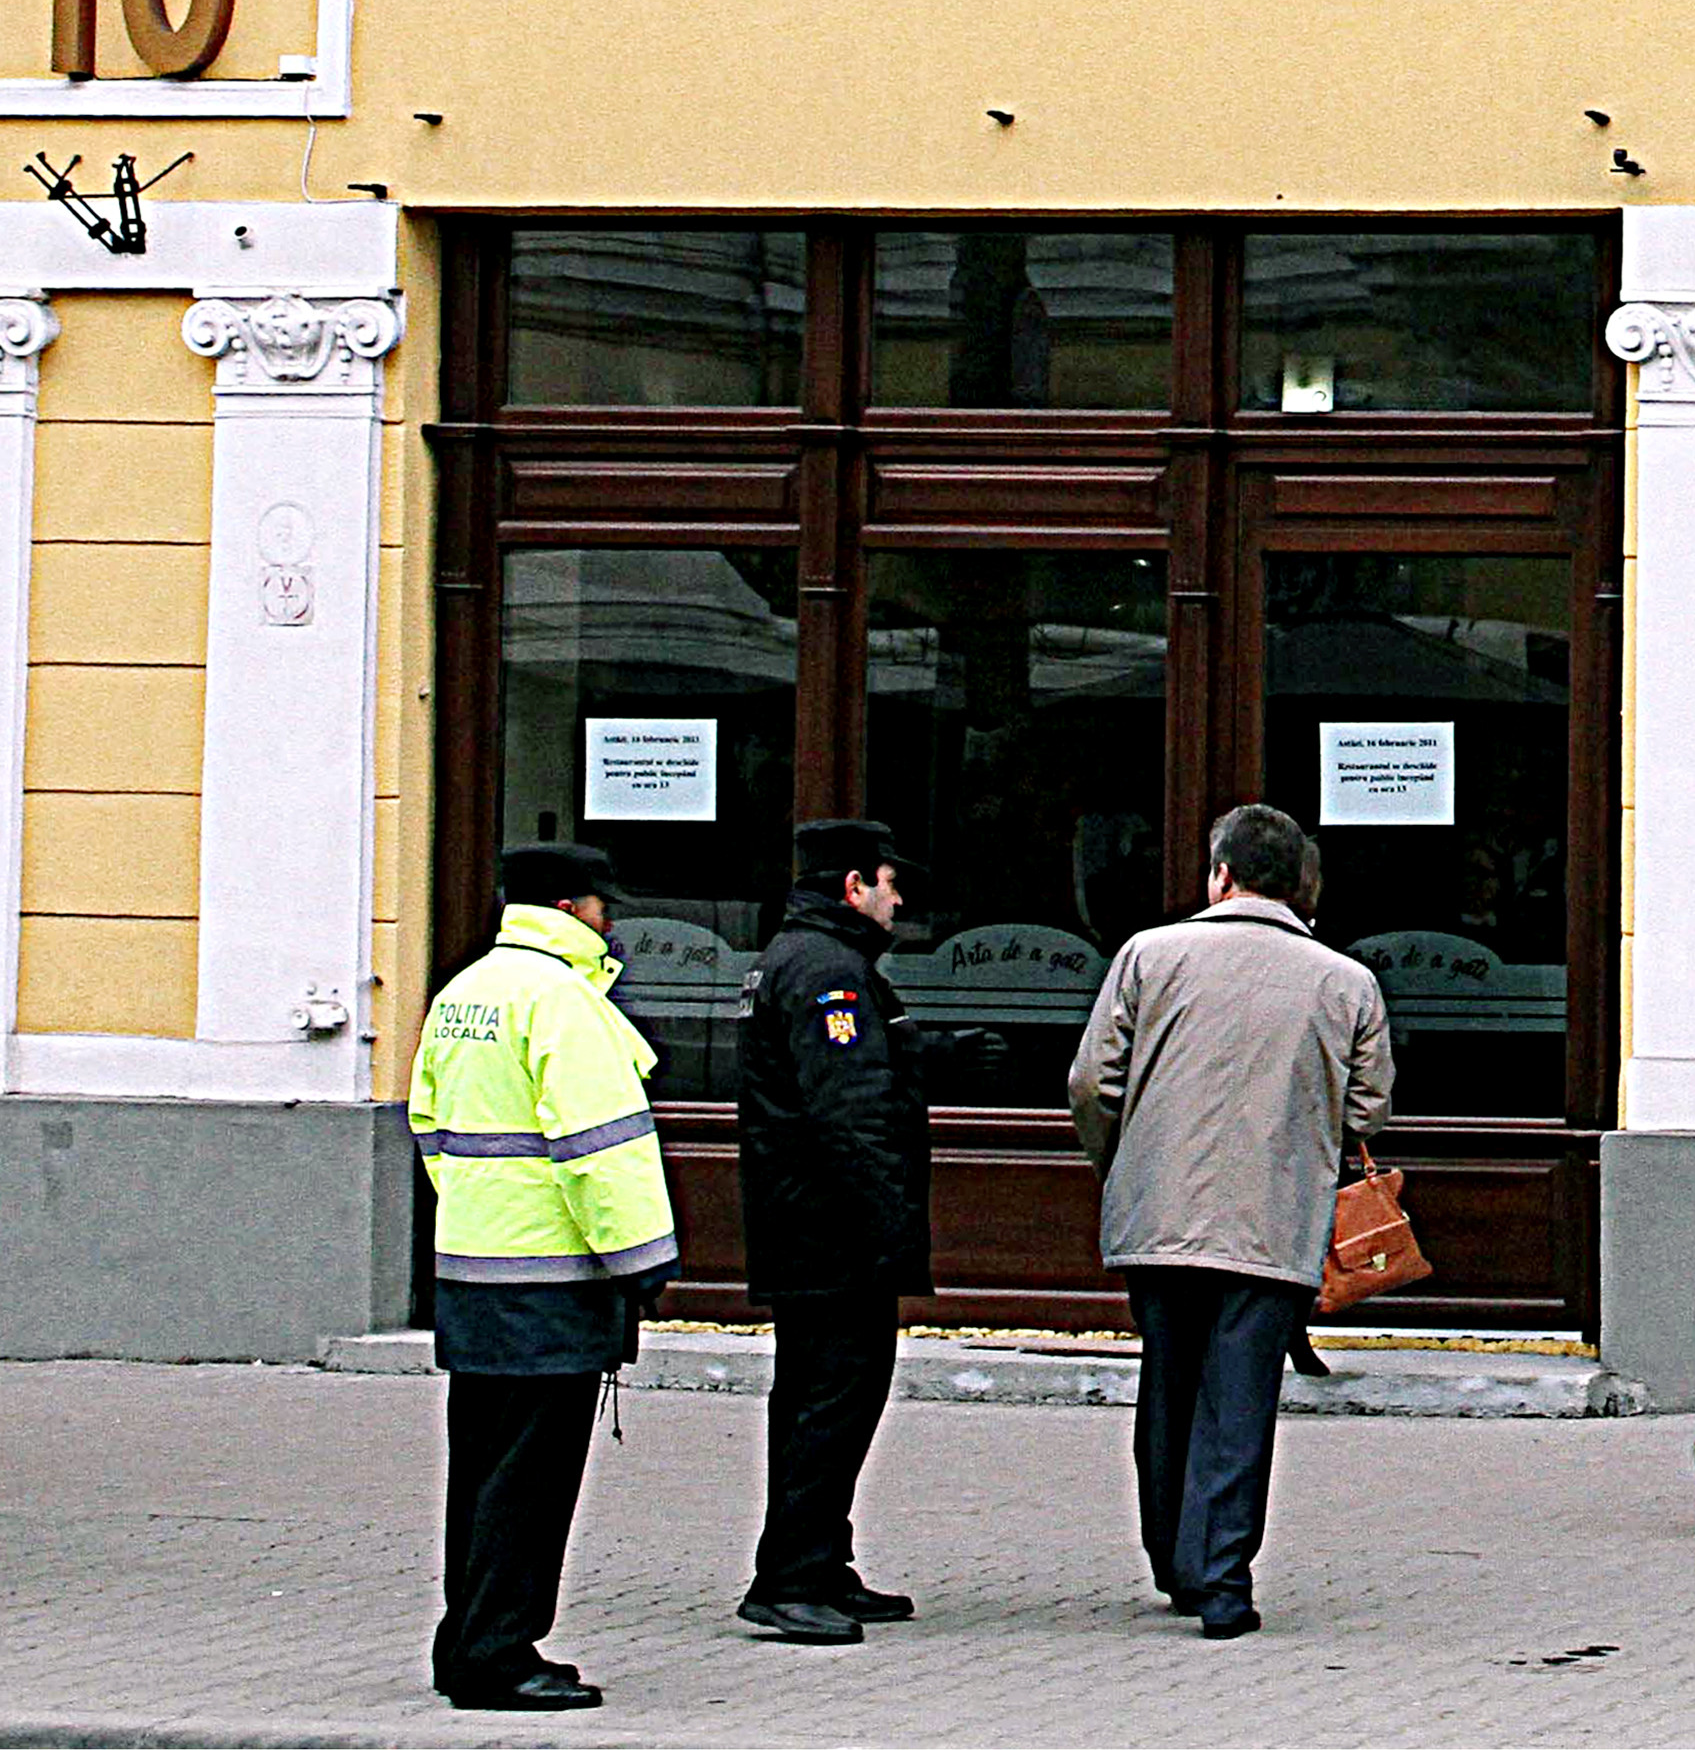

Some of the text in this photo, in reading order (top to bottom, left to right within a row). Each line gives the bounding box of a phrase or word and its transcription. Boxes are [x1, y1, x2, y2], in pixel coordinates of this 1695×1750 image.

[952, 940, 993, 974] Arta
[1001, 937, 1021, 962] de
[1030, 947, 1043, 962] a
